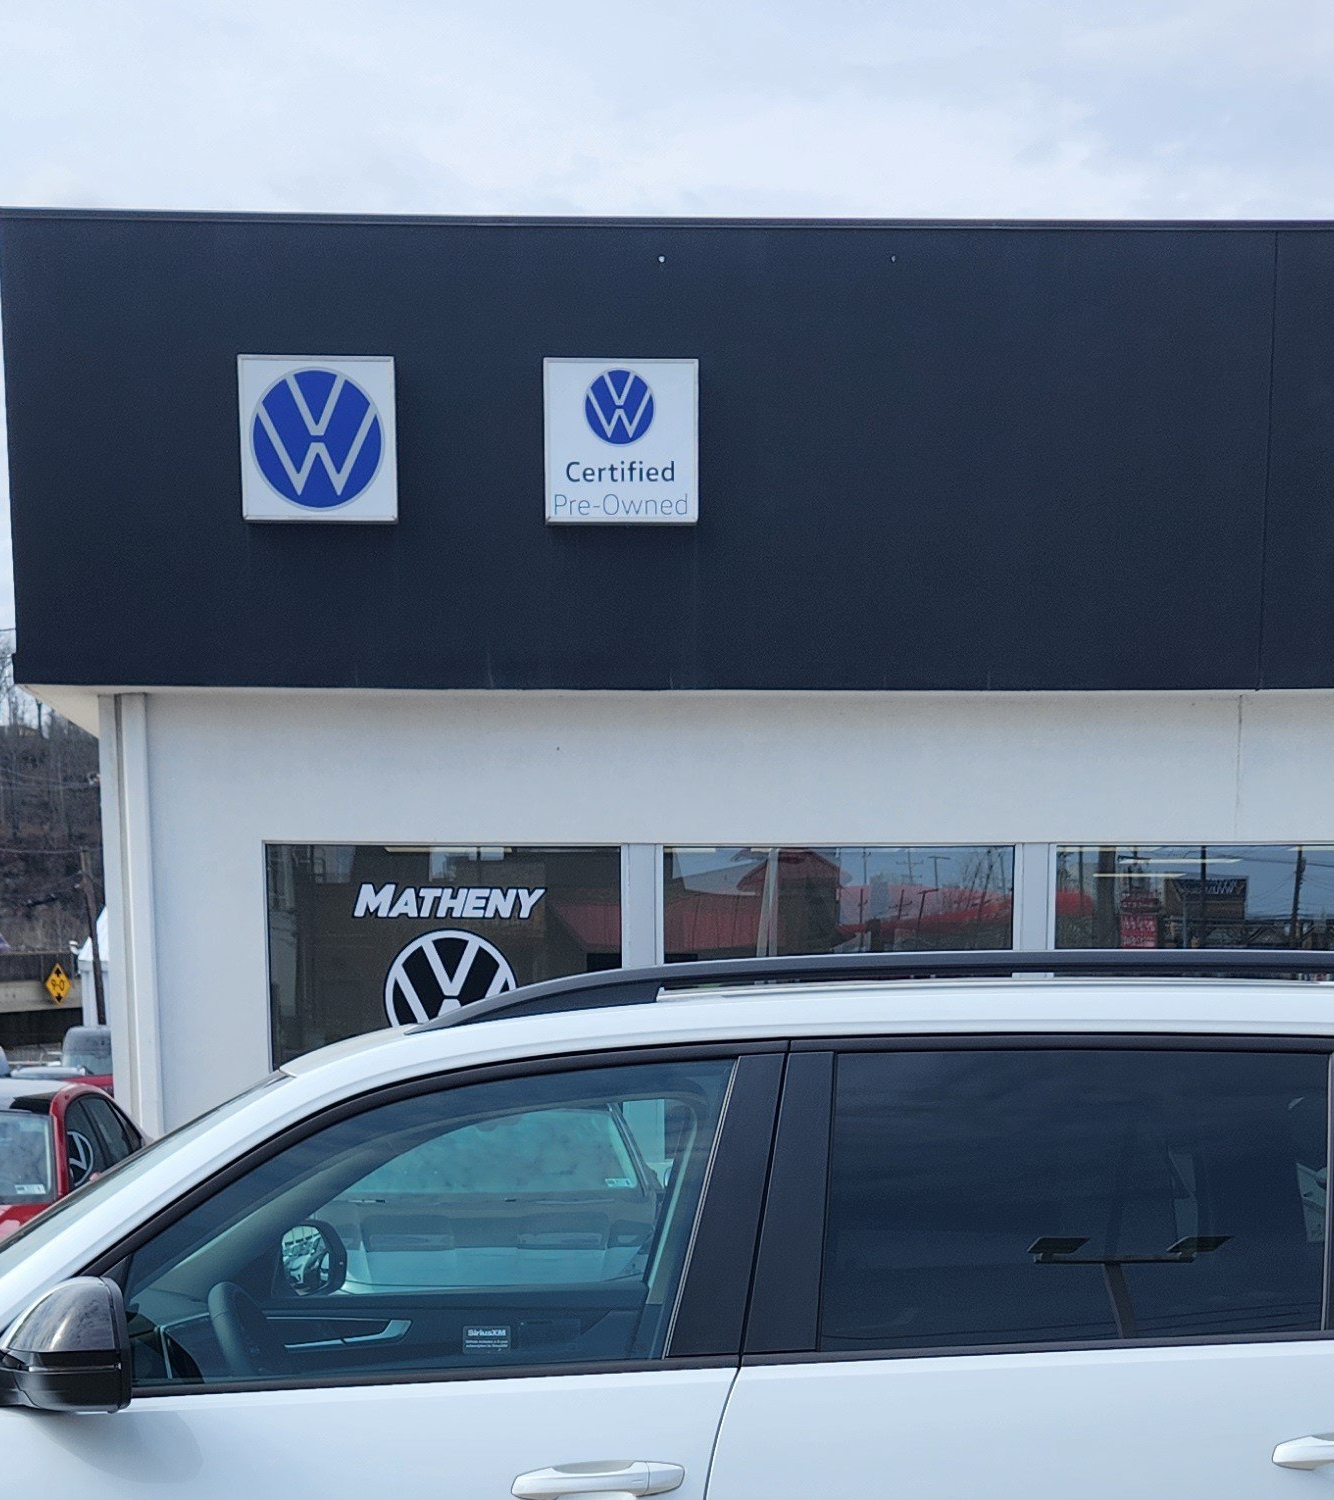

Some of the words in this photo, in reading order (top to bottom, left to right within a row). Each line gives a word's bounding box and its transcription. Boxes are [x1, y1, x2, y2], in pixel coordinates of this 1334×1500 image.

[565, 460, 675, 483] Certified
[553, 492, 689, 516] Pre-Owned
[353, 882, 546, 919] MATHENY
